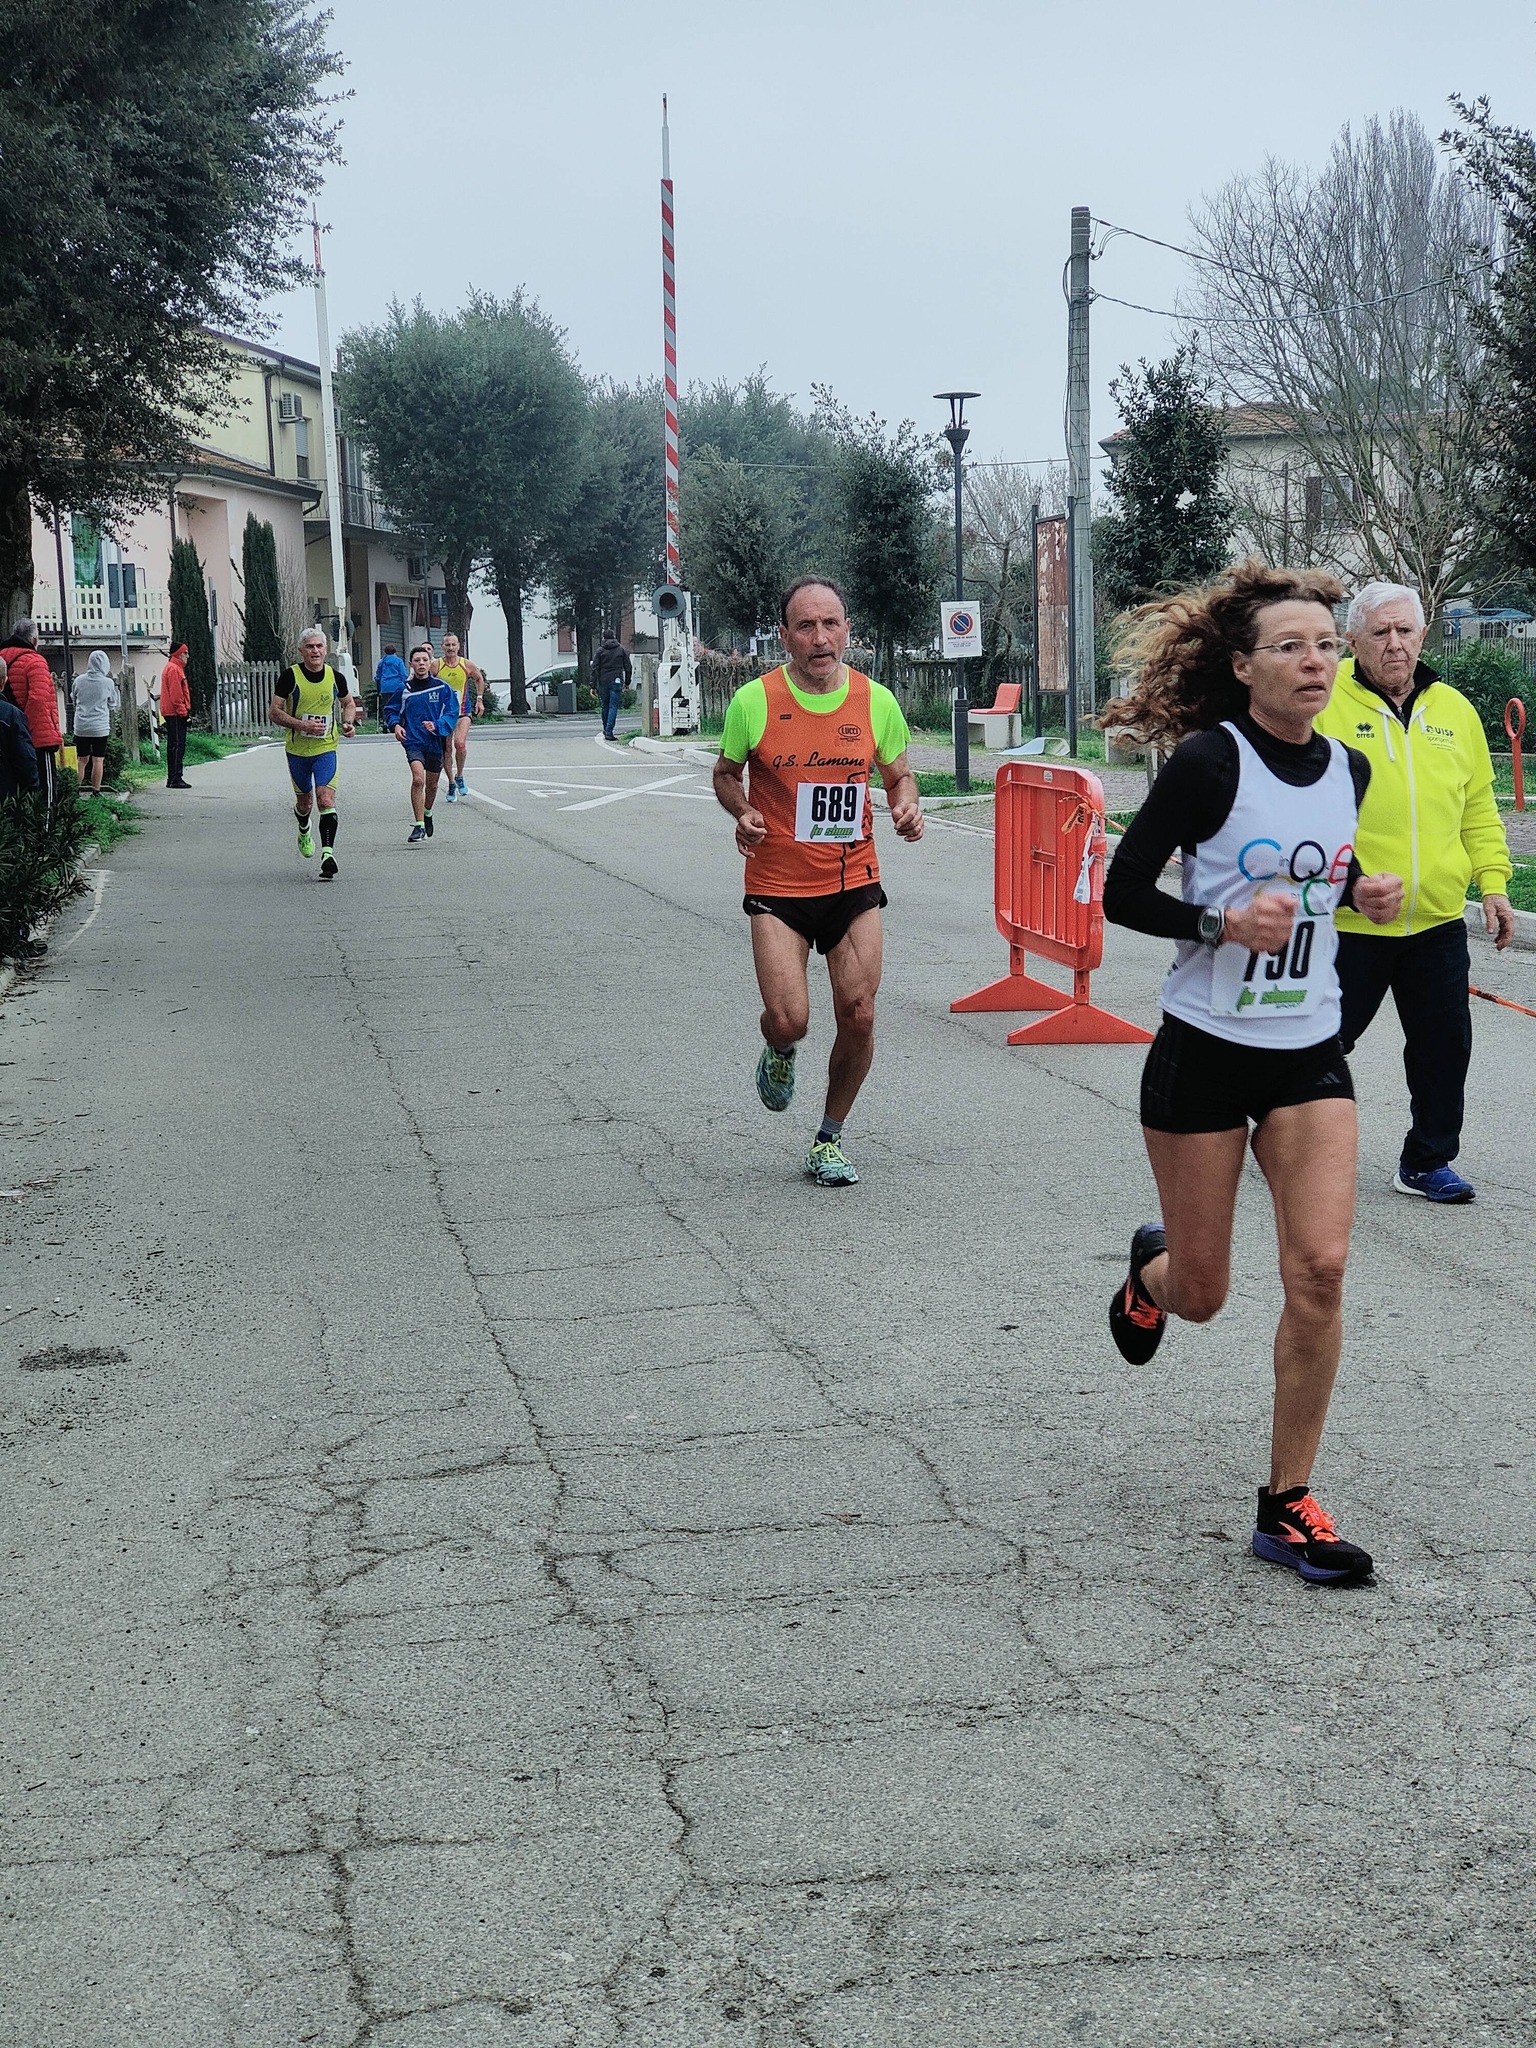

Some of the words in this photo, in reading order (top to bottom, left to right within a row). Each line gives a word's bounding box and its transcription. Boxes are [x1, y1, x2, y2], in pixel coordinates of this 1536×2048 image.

[841, 727, 858, 735] LUCCI
[1434, 726, 1454, 737] UISP
[772, 754, 799, 770] G.S.
[803, 751, 865, 767] Lamone
[811, 785, 858, 822] 689
